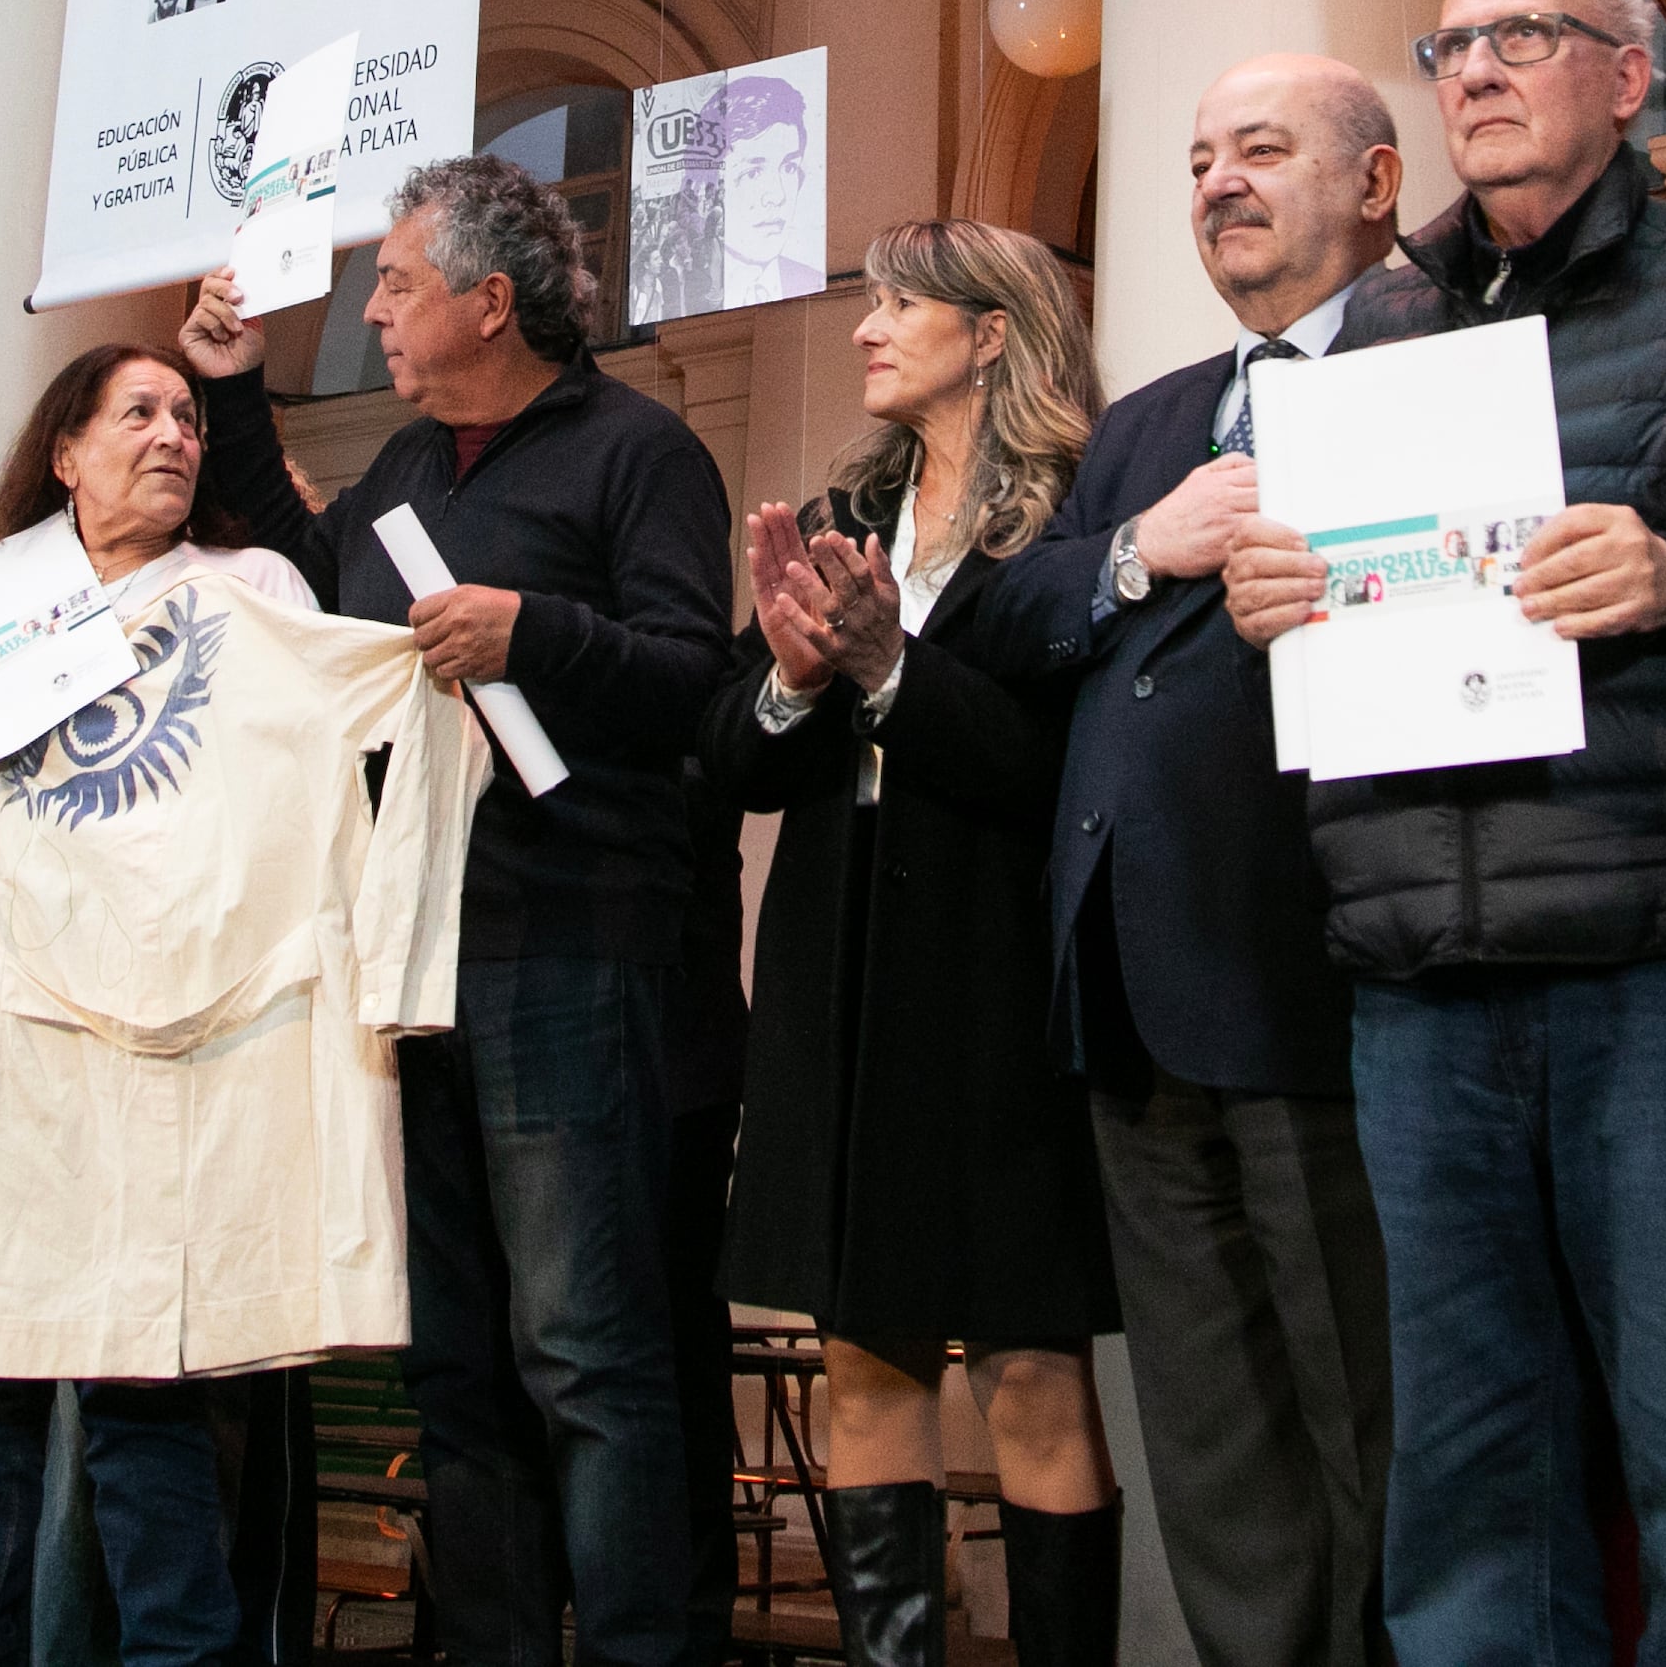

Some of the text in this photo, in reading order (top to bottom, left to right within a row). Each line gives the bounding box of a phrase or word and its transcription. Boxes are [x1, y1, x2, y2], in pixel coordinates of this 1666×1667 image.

[354, 44, 438, 87] ERSIDAD
[348, 87, 403, 122] ONAL
[97, 109, 182, 150] EDUCACIÓN
[339, 118, 418, 159] A PLATA
[117, 143, 178, 174] PÚBLICA
[93, 176, 175, 211] Y GRATUITA
[1386, 557, 1469, 584] CAUSA
